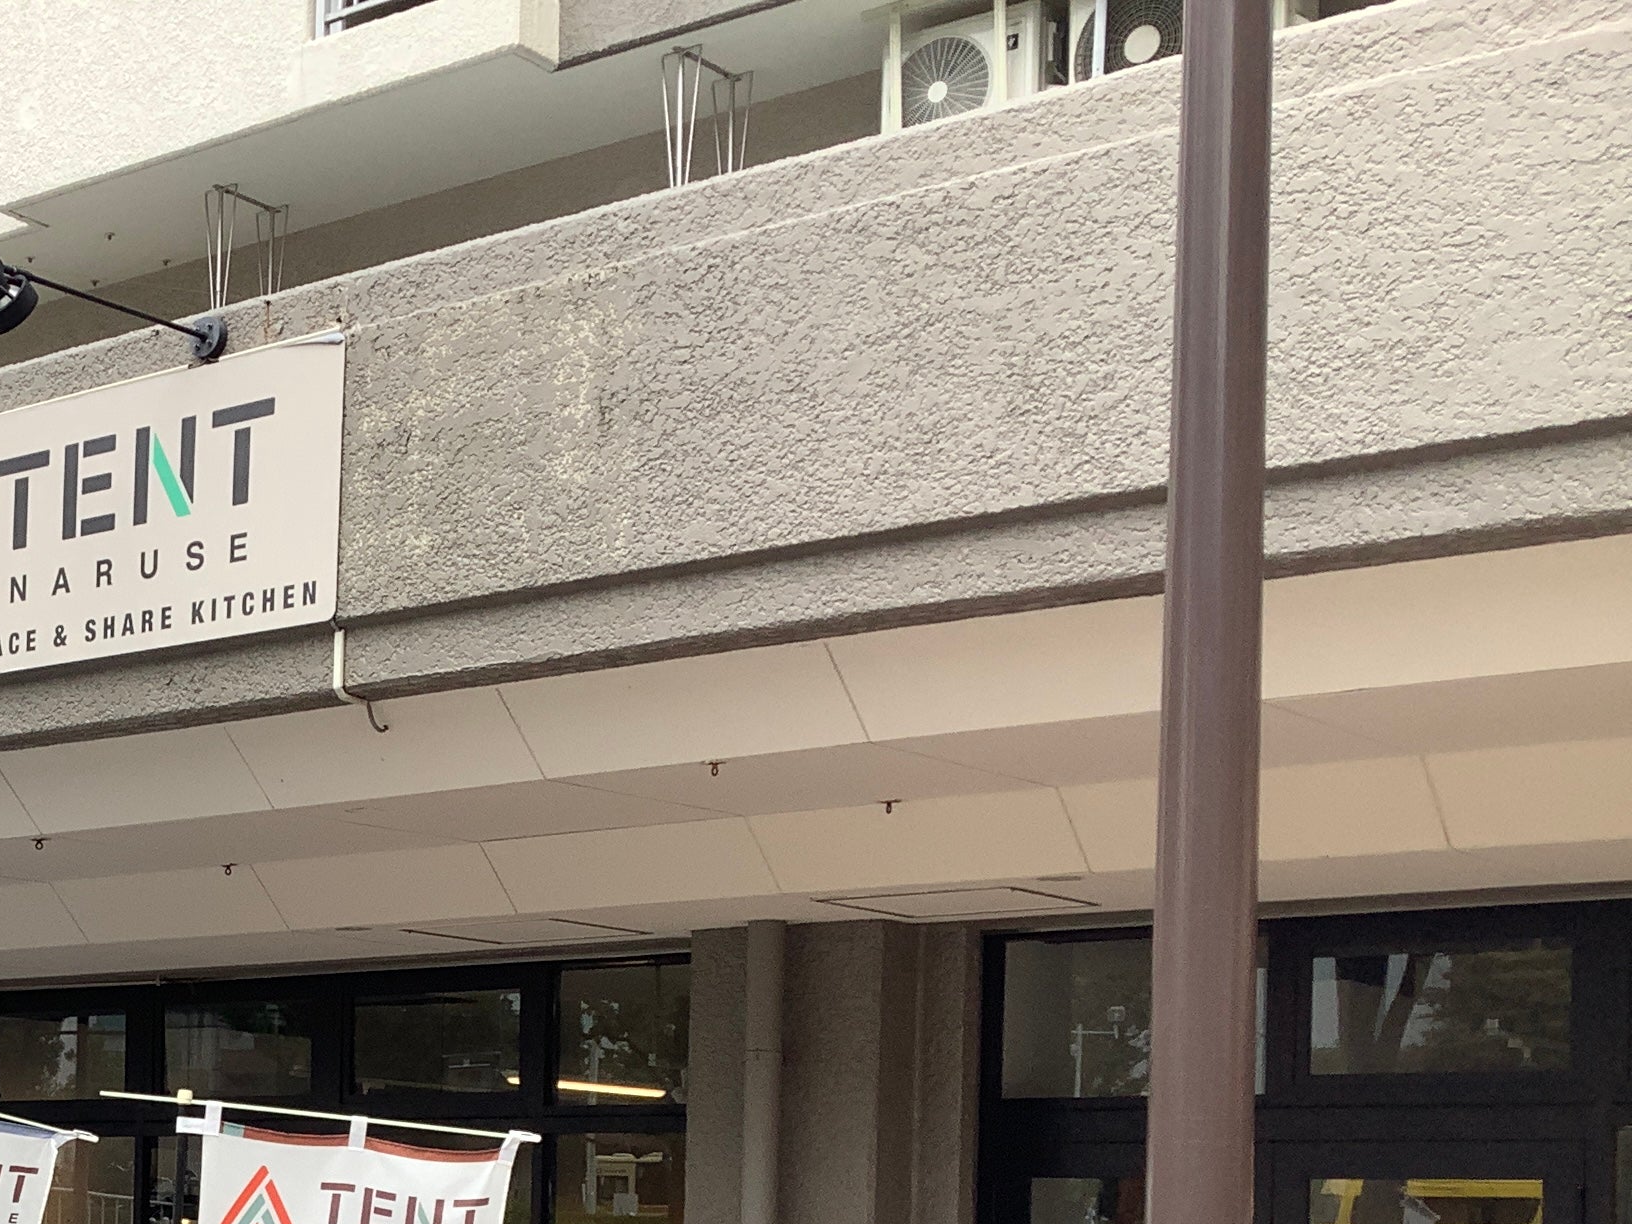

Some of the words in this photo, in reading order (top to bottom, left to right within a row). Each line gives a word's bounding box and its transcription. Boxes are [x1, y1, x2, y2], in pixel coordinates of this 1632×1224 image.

[9, 532, 248, 604] NARUSE
[53, 624, 68, 647] &
[84, 606, 173, 643] SHARE
[191, 579, 318, 626] KITCHEN
